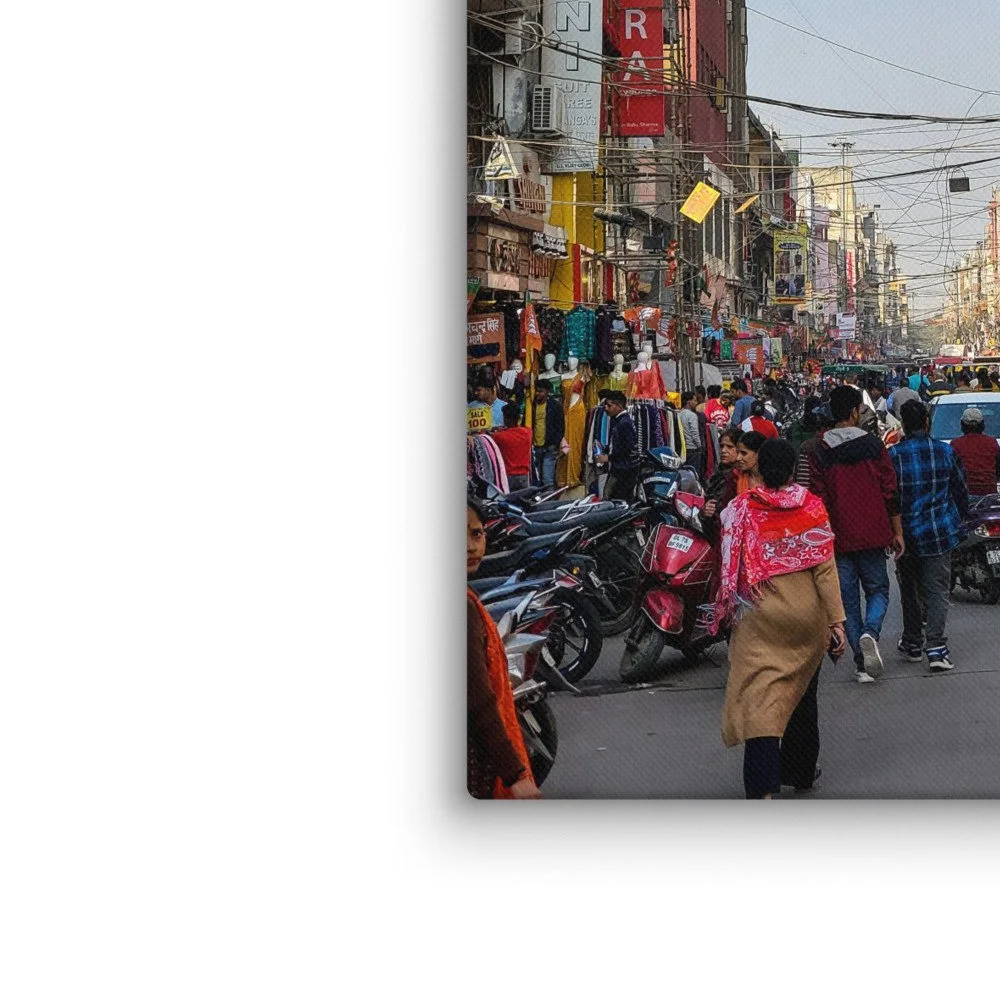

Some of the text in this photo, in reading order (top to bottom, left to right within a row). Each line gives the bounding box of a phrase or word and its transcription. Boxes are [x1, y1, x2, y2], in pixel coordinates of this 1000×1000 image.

[486, 317, 499, 332] सिंह
[470, 410, 484, 418] SALE
[468, 418, 487, 428] 100
